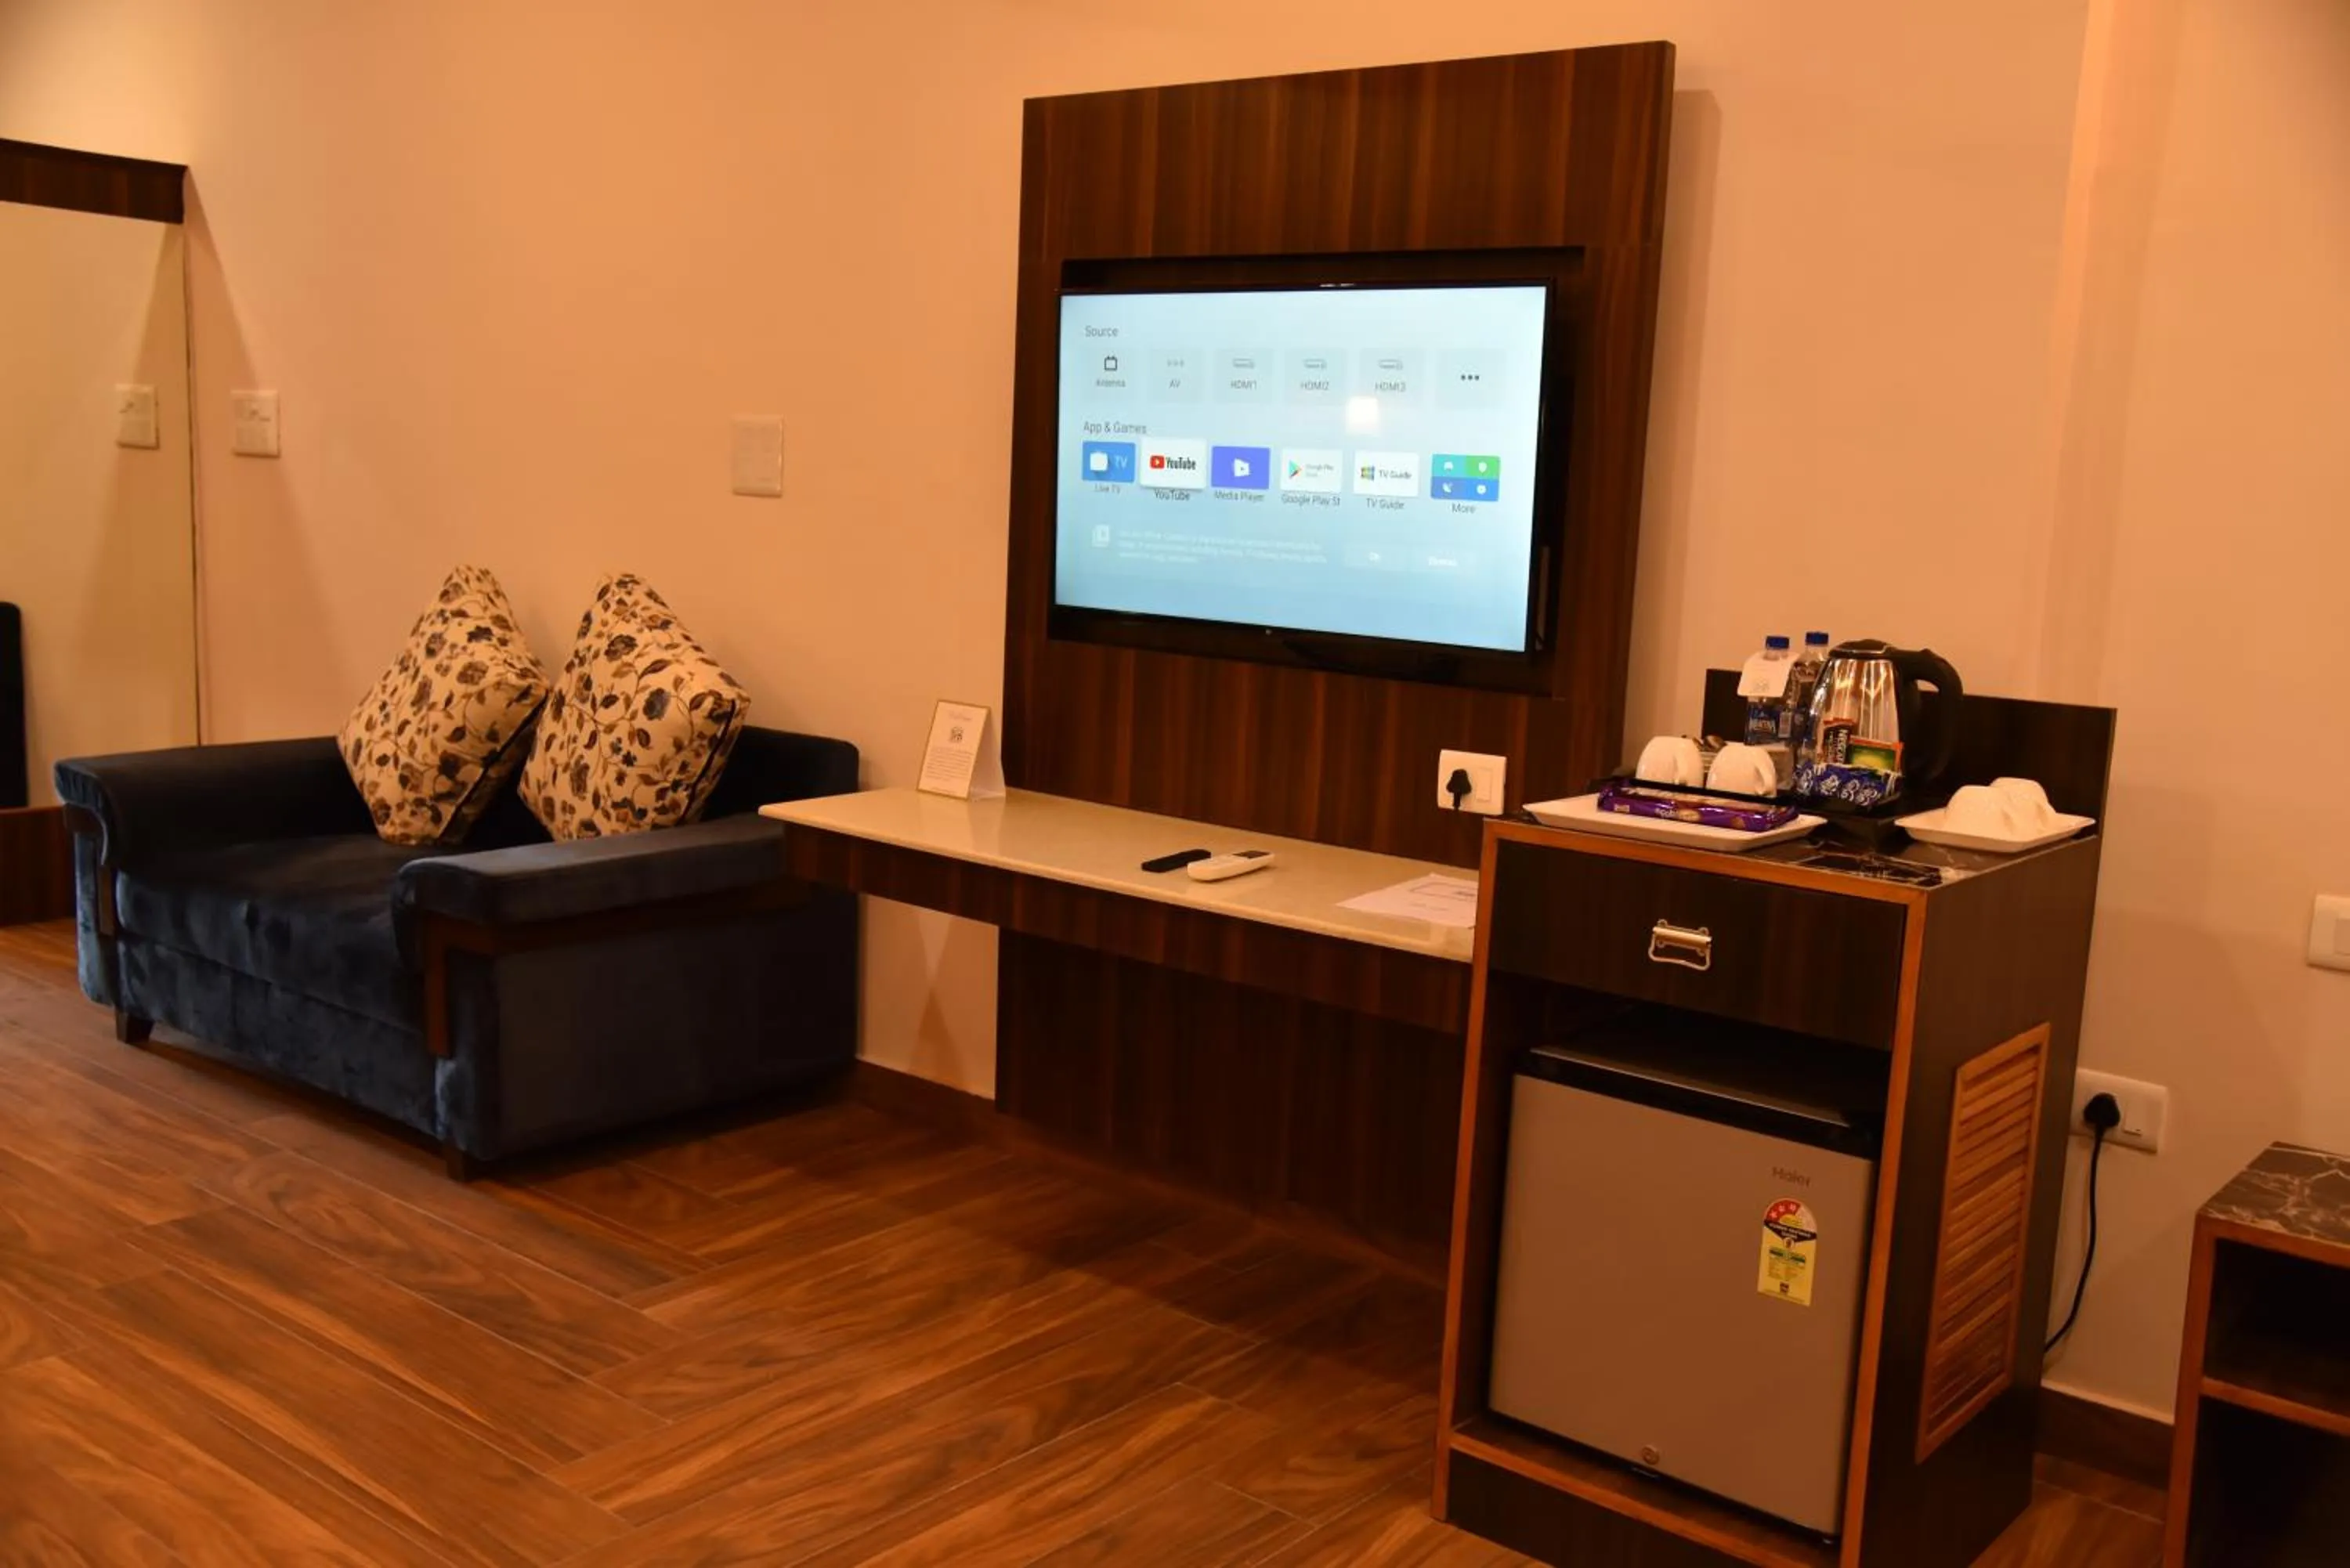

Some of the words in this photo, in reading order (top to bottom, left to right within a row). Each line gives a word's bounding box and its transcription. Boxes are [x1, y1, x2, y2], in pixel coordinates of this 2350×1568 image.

[1085, 325, 1119, 338] Source
[1169, 379, 1180, 388] AV
[1083, 421, 1102, 435] App
[1104, 422, 1111, 432] &
[1113, 421, 1148, 434] Games
[1113, 456, 1128, 468] TV
[1166, 457, 1196, 471] YouTube
[1379, 470, 1389, 479] TV
[1155, 489, 1191, 501] YouTube
[1281, 493, 1311, 507] Google
[1366, 498, 1377, 508] TV
[1379, 499, 1405, 510] Guide
[1452, 503, 1477, 514] More
[1772, 1166, 1811, 1188] Haier
